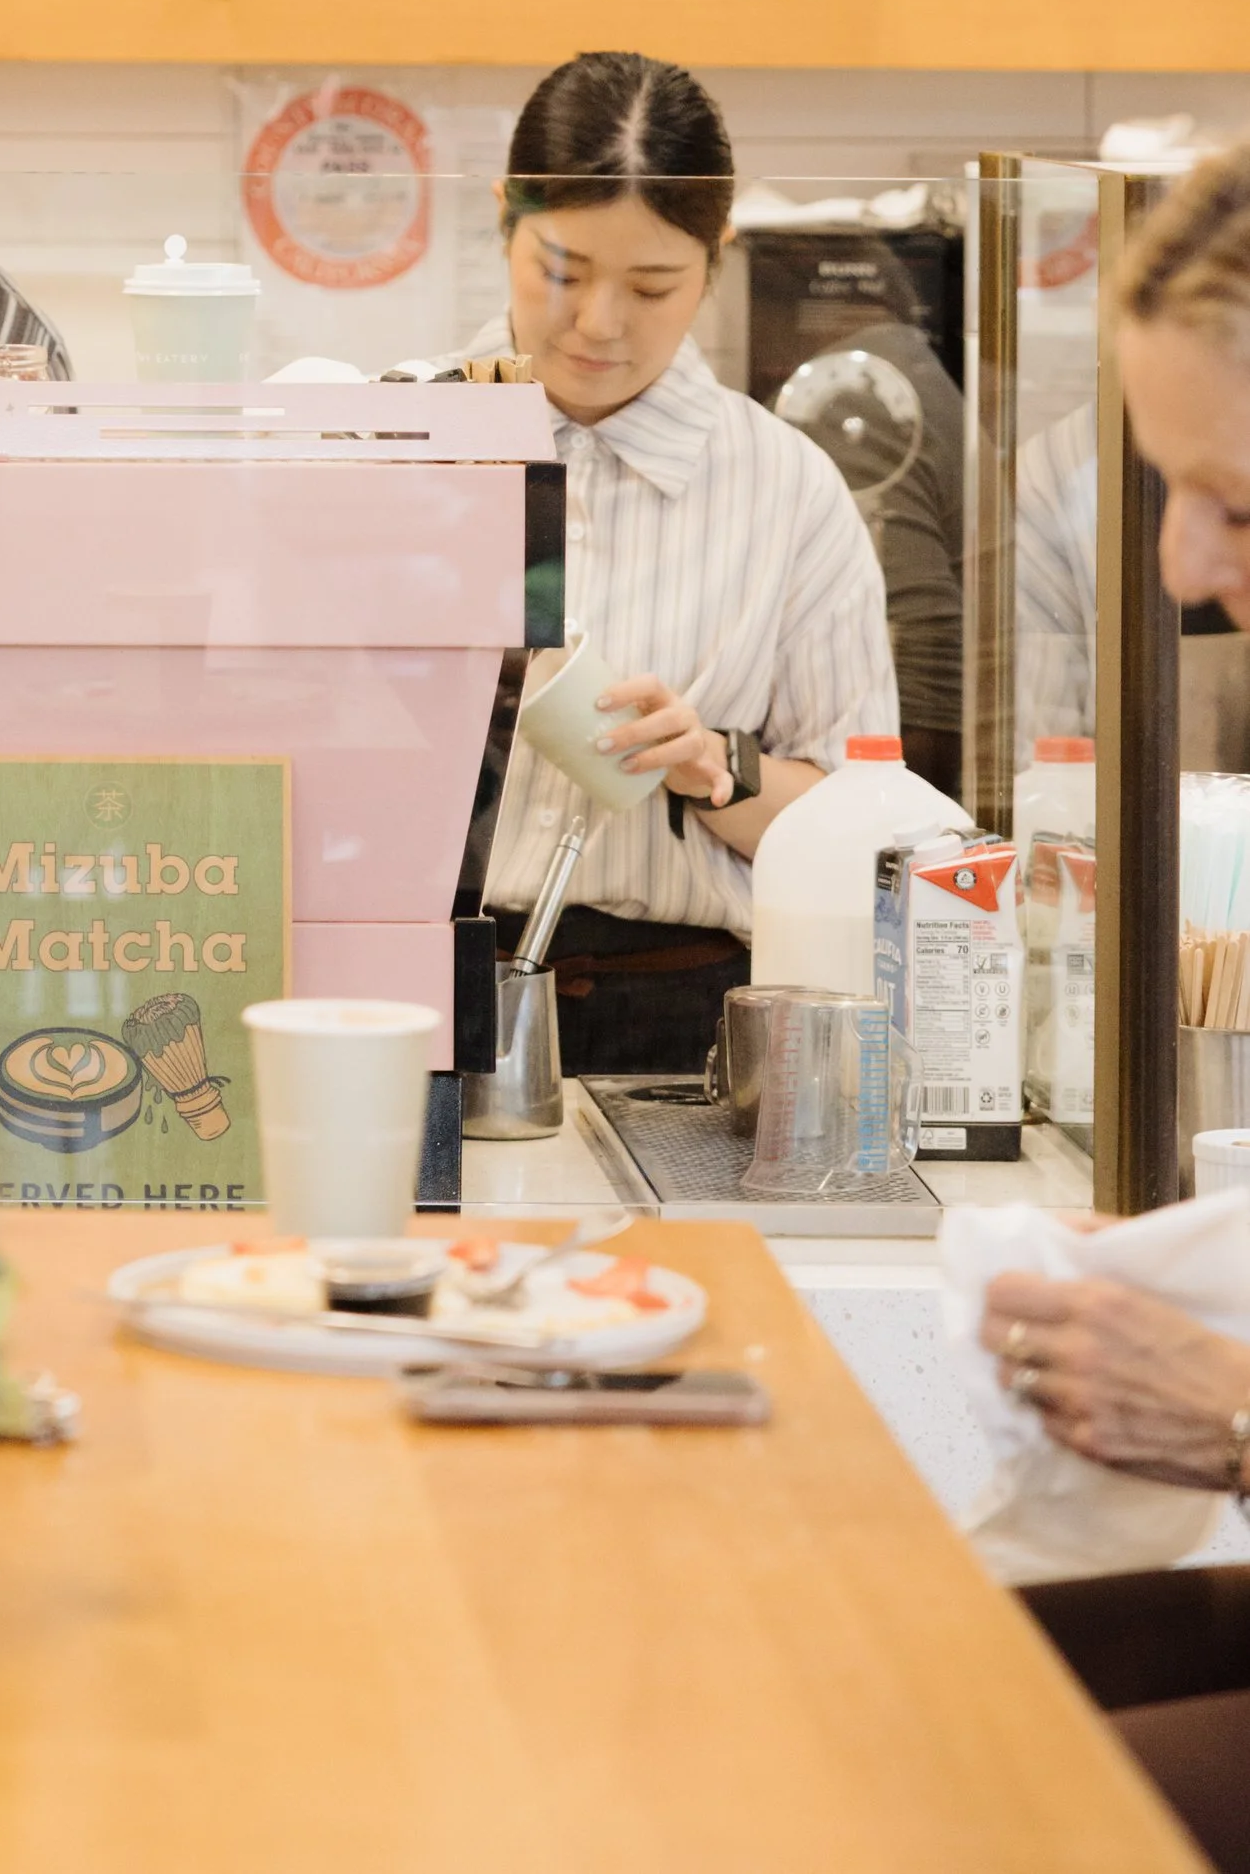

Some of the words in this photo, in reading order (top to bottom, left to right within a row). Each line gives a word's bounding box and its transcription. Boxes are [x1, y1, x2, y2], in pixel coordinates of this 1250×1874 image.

[93, 789, 125, 821] 茶
[916, 921, 947, 929] Nutrition
[950, 921, 969, 929] Facts
[916, 947, 945, 955] Calories
[957, 945, 969, 954] 70
[144, 1184, 246, 1211] HERE
